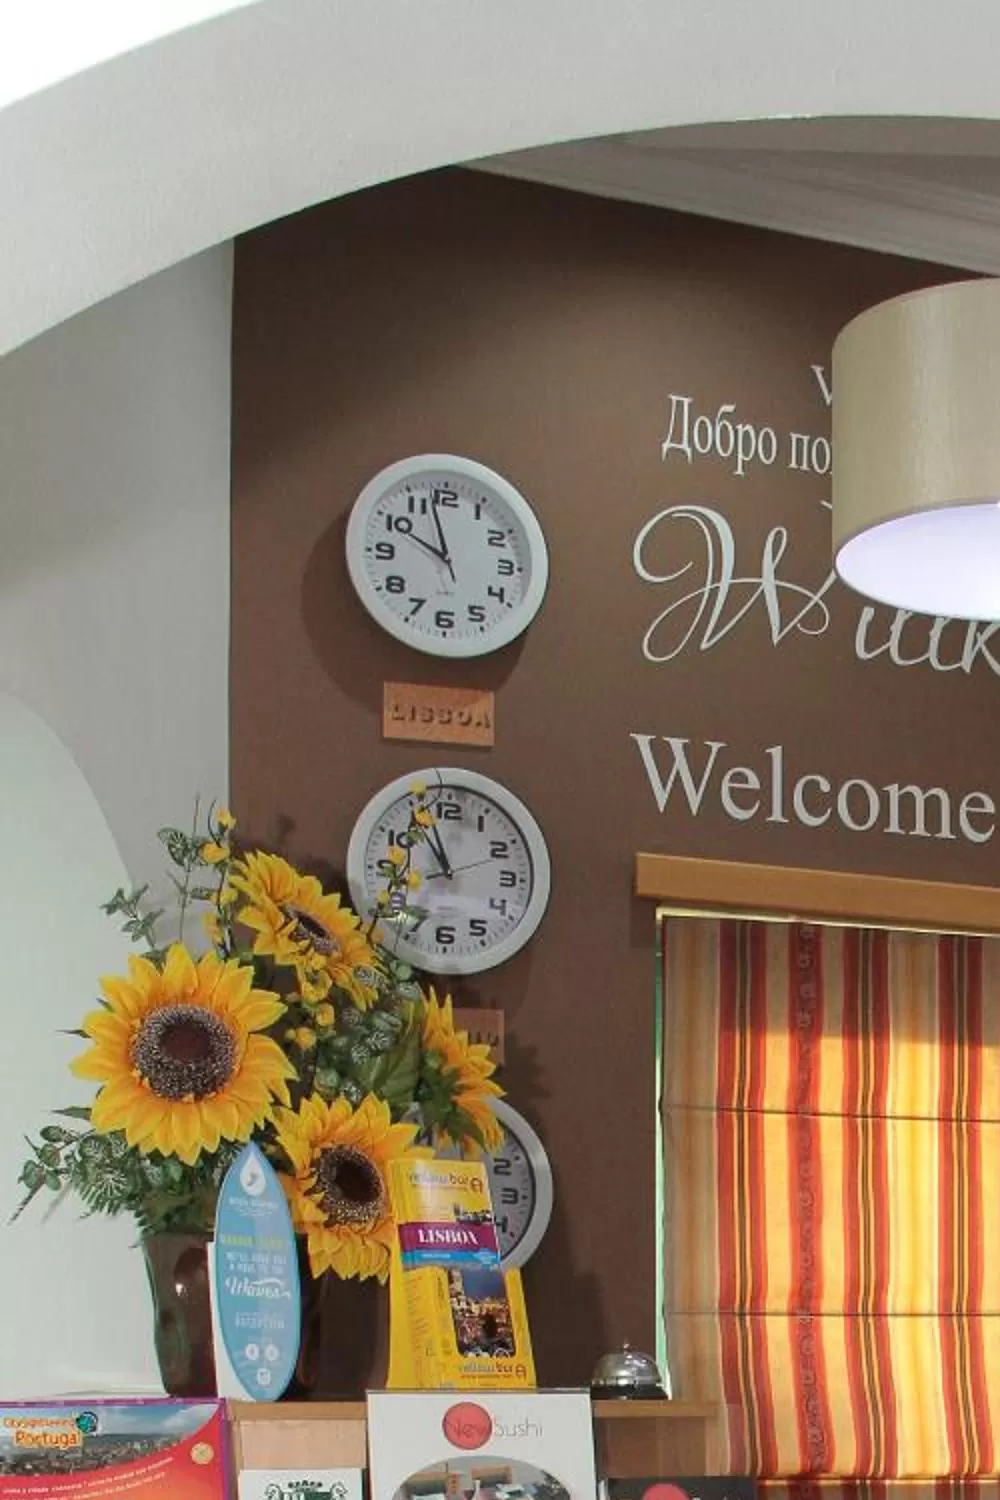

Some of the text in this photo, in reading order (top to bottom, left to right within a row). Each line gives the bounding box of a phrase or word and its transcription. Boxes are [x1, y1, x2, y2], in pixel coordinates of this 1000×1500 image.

[662, 395, 832, 476] Добро по
[408, 495, 427, 514] 11
[434, 489, 459, 508] 12
[474, 503, 482, 520] 1
[386, 514, 413, 535] 10
[487, 530, 506, 548] 2
[375, 542, 395, 561] 9
[497, 559, 515, 576] 3
[385, 575, 406, 594] 8
[488, 585, 505, 604] 4
[409, 598, 427, 616] 7
[467, 605, 486, 623] 5
[435, 610, 455, 629] 6
[630, 731, 997, 844] Welcome
[436, 802, 462, 821] 12
[477, 814, 485, 833] 1
[489, 841, 509, 859] 2
[499, 870, 517, 887] 3
[489, 897, 507, 916] 4
[435, 926, 456, 945] 6
[469, 919, 487, 937] 5
[493, 1157, 512, 1176] 2
[500, 1187, 519, 1206] 3
